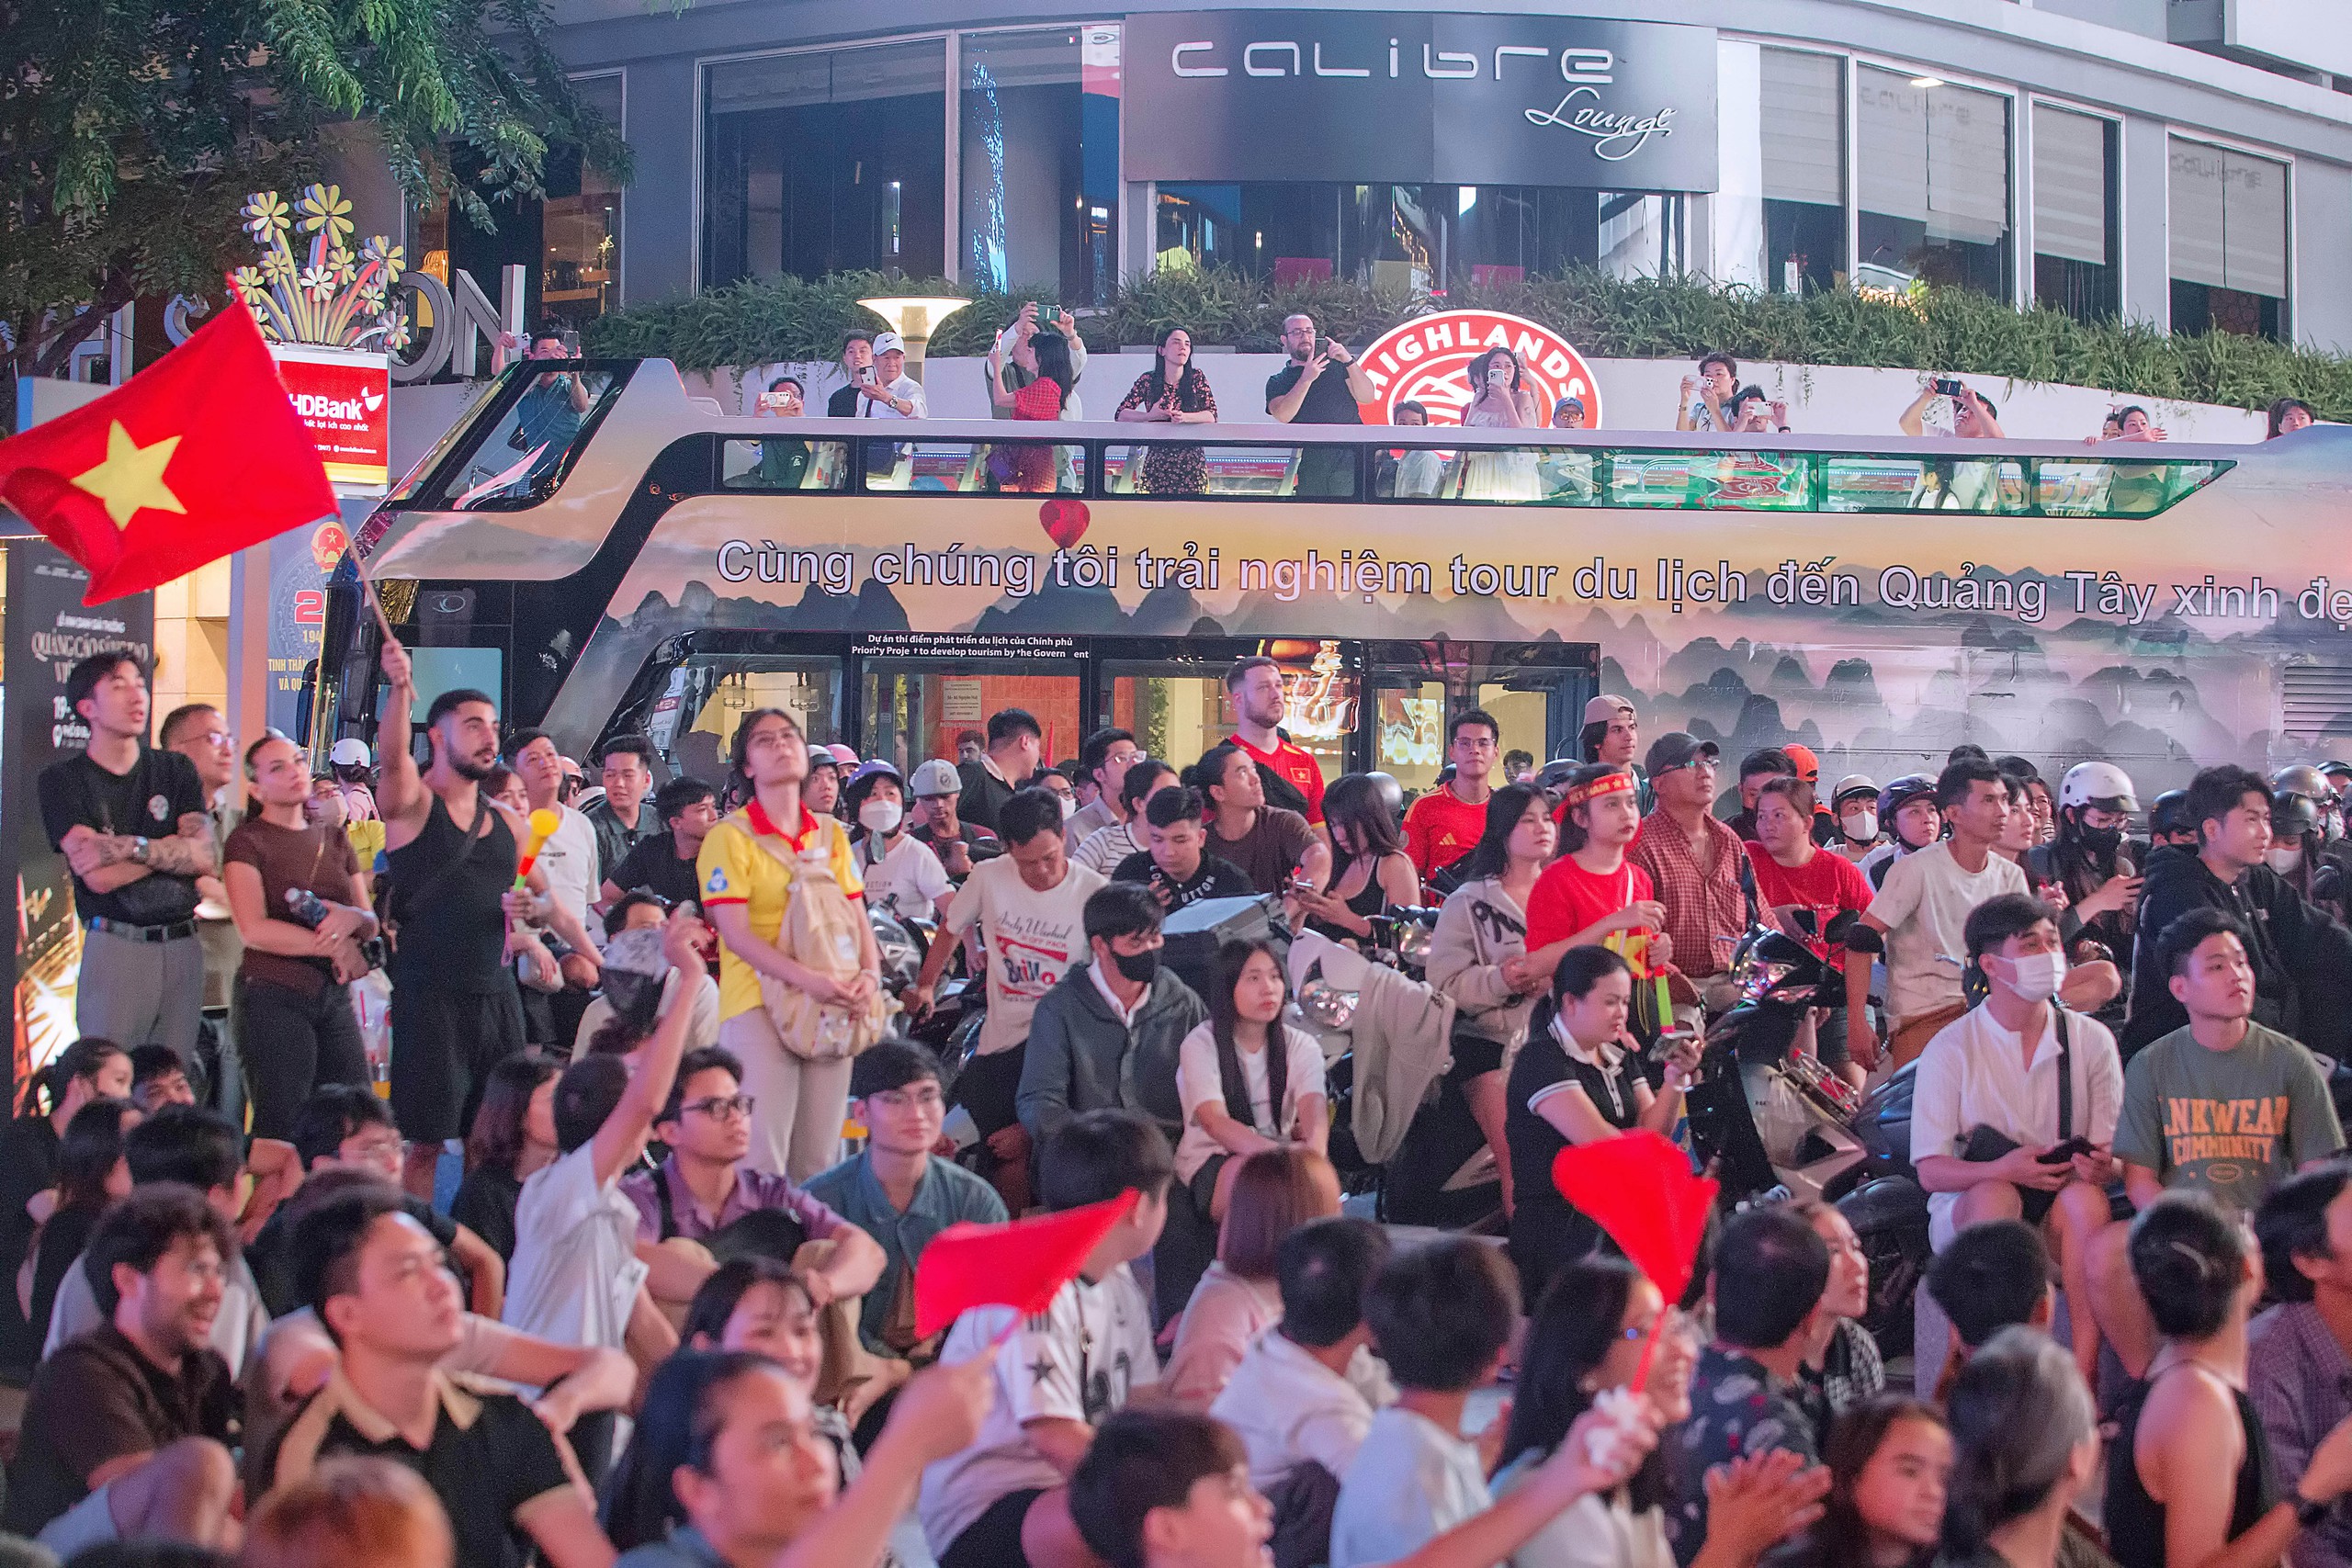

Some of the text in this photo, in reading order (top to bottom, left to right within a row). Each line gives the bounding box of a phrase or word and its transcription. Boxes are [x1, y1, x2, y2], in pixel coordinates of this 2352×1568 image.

[1524, 86, 1678, 161] Lounge
[1363, 321, 1588, 401] HIGHLANDS
[288, 393, 363, 421] HDBank
[717, 539, 2352, 632] Cùng chúng tôi trải nghiệm tour du lịch đến Quảng Tây xinh đẹ
[302, 629, 322, 644] 194
[868, 633, 1073, 648] Dự án thí điểm phát triển du lịch của Chính phủ
[930, 647, 967, 658] develop
[967, 648, 1002, 657] tourism
[1003, 648, 1016, 659] by
[1033, 649, 1089, 659] Governent
[267, 658, 287, 671] TINH
[290, 677, 303, 692] QU
